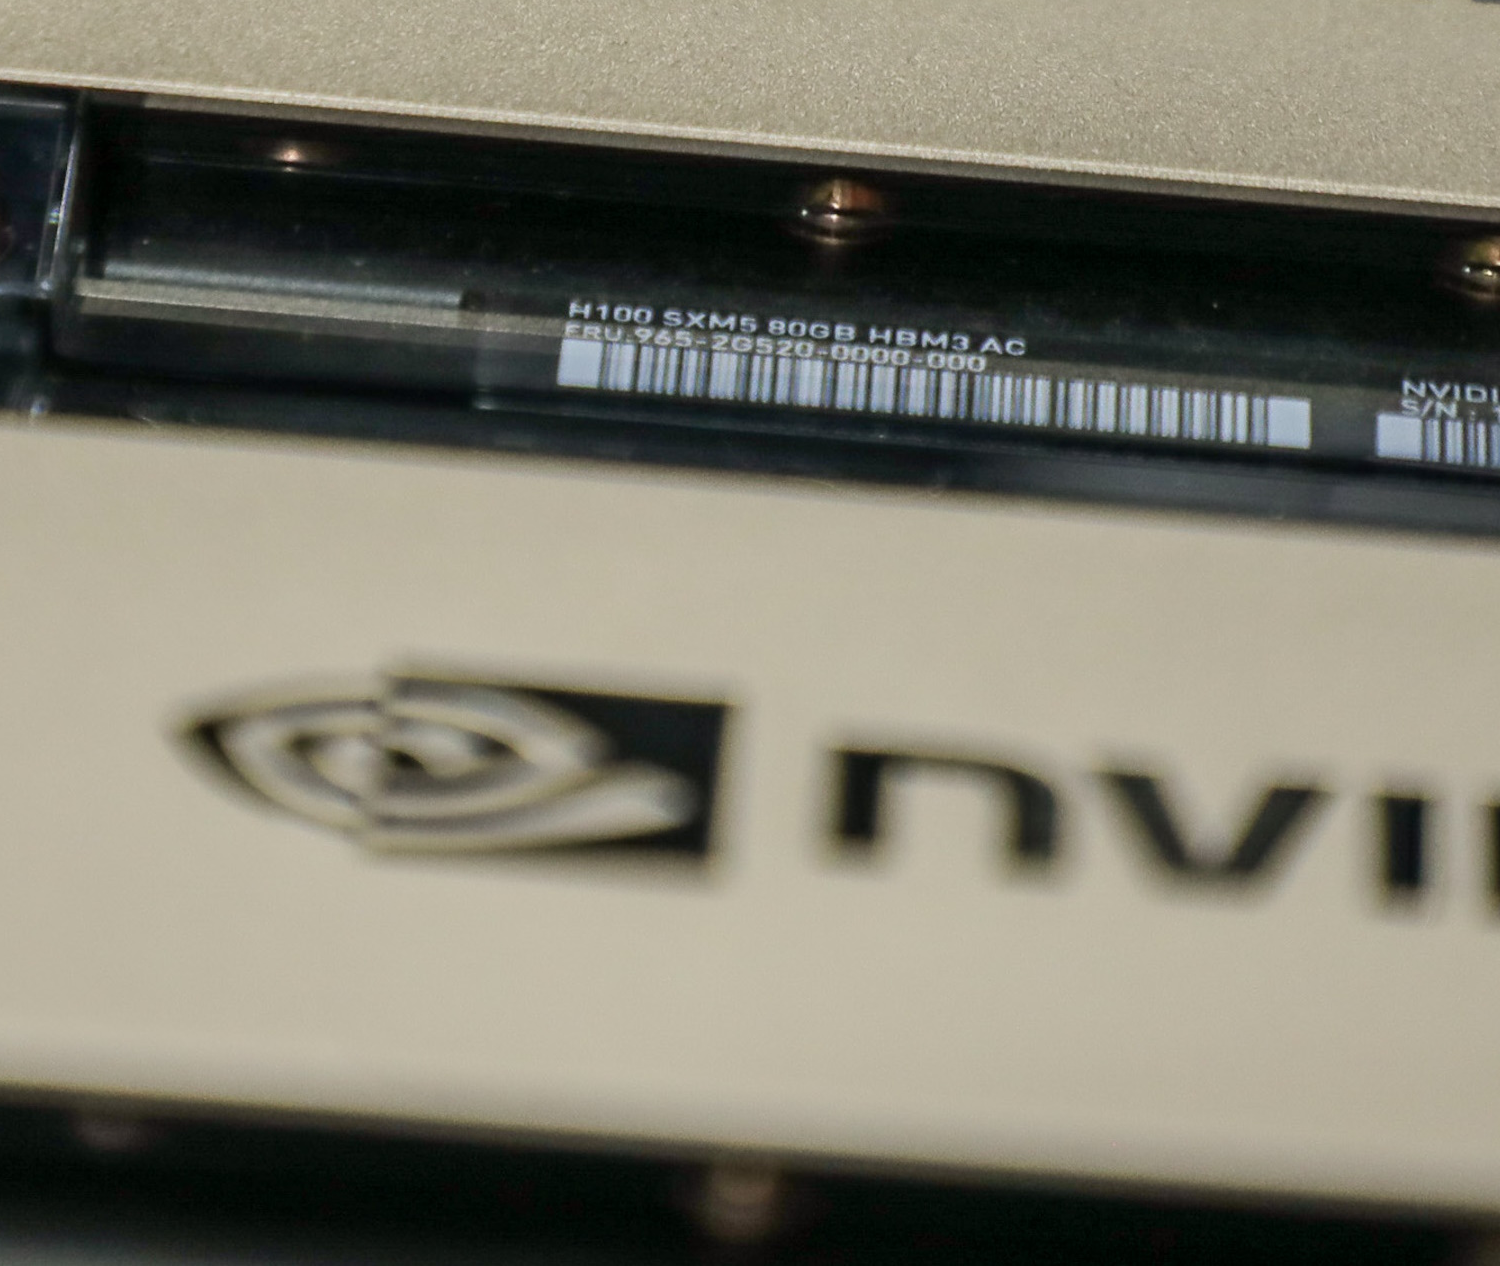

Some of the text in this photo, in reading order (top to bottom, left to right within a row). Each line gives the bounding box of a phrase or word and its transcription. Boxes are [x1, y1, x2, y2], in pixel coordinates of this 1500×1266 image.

[569, 299, 1027, 356] H100 SXM5 80GB HBM3 AC
[1401, 398, 1457, 420] S/N
